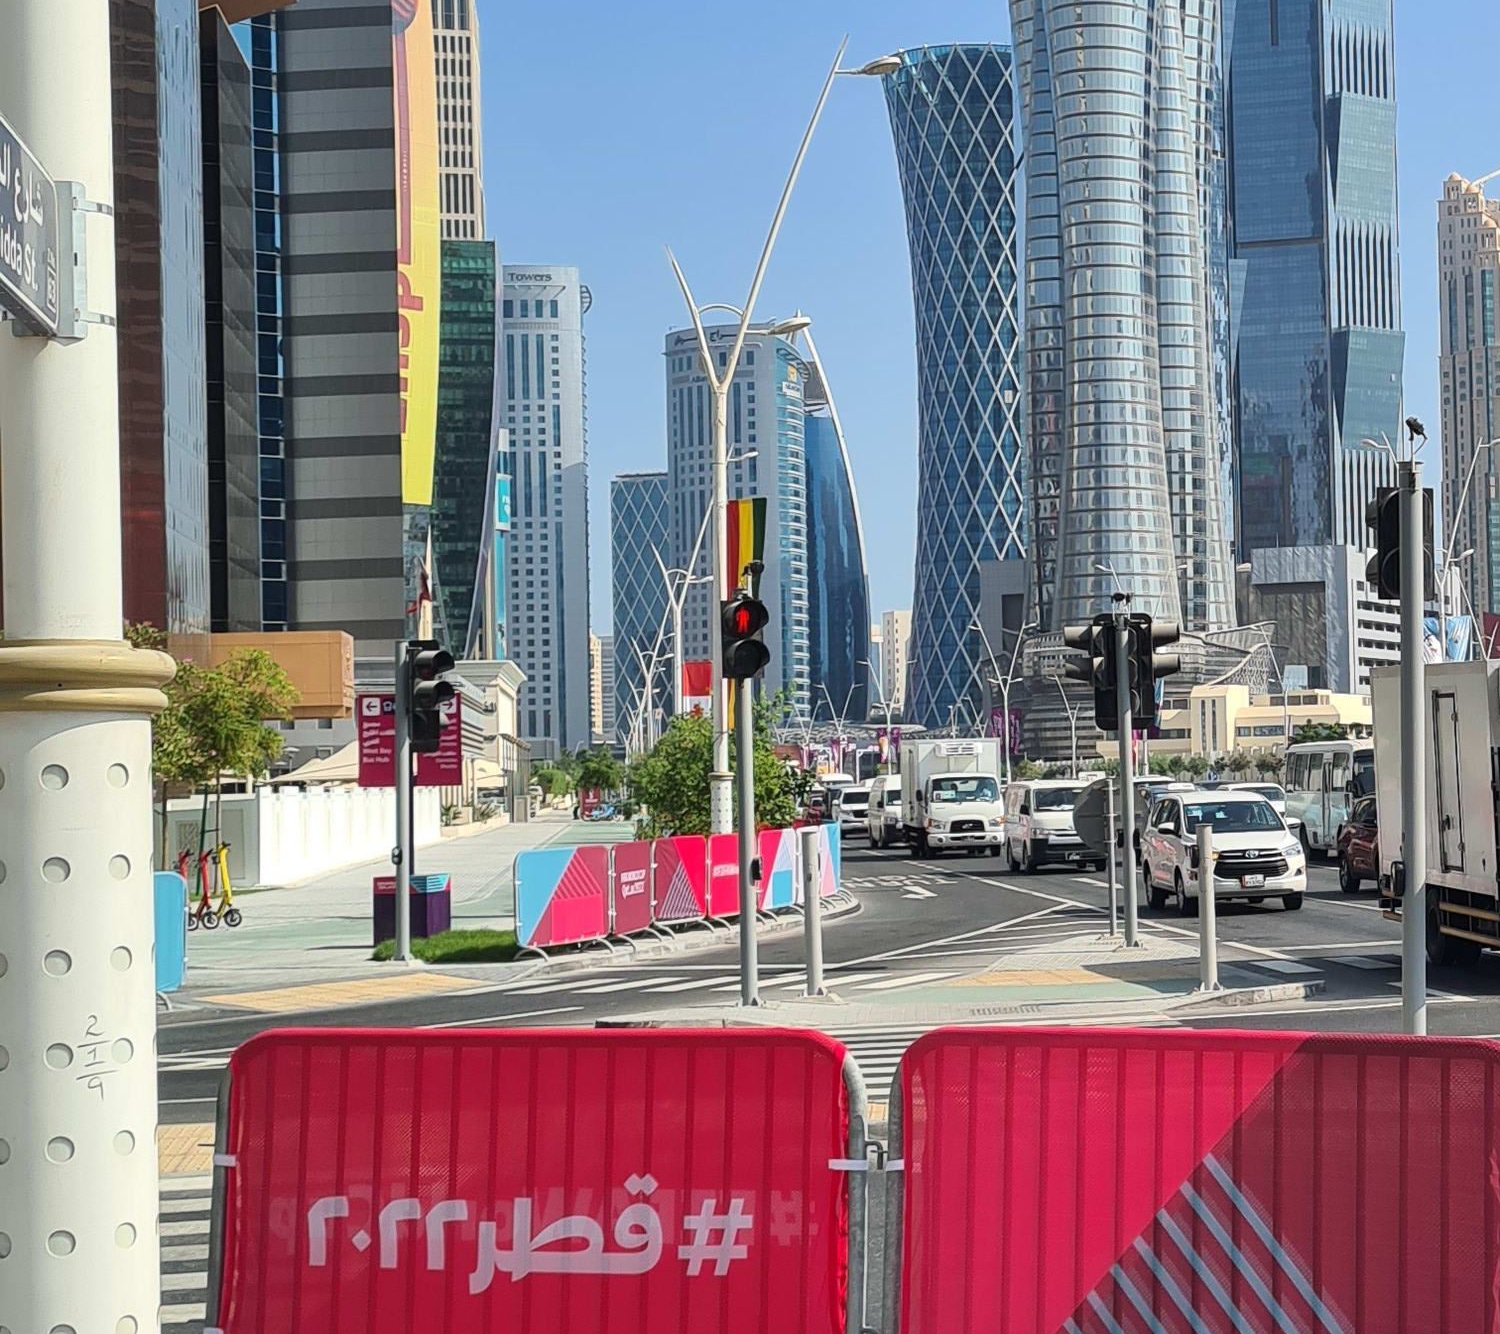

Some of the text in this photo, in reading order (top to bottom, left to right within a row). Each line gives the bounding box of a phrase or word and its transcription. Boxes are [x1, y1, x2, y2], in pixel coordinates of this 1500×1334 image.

[0, 214, 23, 276] idda
[24, 242, 39, 292] St.
[507, 272, 553, 282] Towers
[85, 1014, 105, 1037] 2
